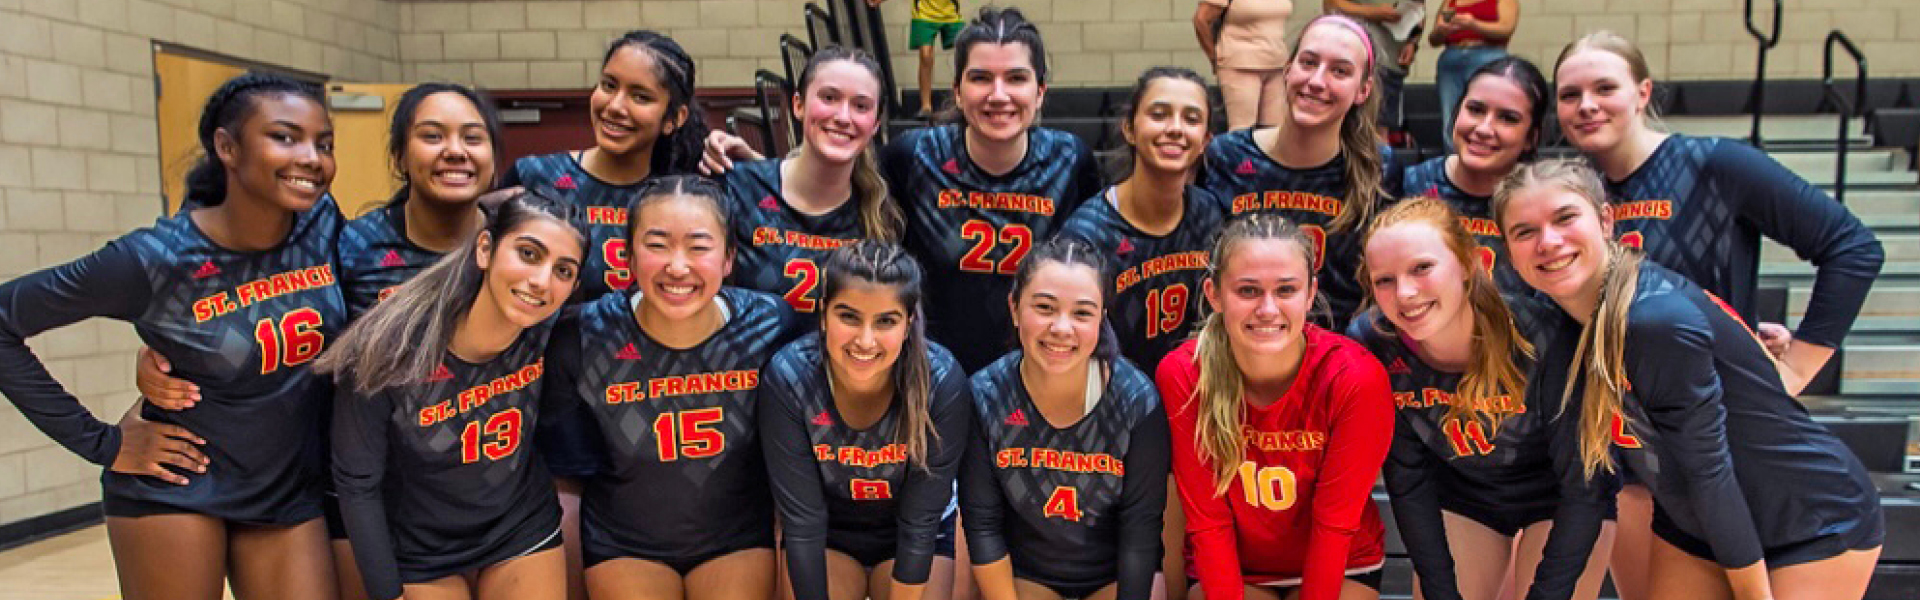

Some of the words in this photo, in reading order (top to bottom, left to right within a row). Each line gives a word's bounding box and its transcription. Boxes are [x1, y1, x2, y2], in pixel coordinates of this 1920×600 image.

[939, 189, 967, 208] ST.
[969, 191, 1055, 216] FRANCIS
[1232, 192, 1260, 215] ST.
[1263, 190, 1342, 216] FRANCI
[752, 226, 784, 247] ST.
[959, 219, 1033, 274] 22
[192, 290, 238, 323] ST.
[236, 262, 336, 308] FRANCIS
[783, 257, 827, 313] 2
[1116, 266, 1141, 293] ST.
[1145, 283, 1189, 339] 19
[255, 305, 325, 375] 16
[606, 380, 645, 404] ST.
[649, 368, 759, 399] FRANCIS
[419, 398, 456, 427] ST.
[461, 407, 522, 463] 13
[653, 406, 725, 462] 15
[1240, 425, 1325, 452] FRANCIS
[813, 443, 836, 462] T.
[838, 443, 908, 468] FRANC
[996, 447, 1028, 469] ST.
[1031, 447, 1125, 477] FRANCIS
[1043, 485, 1084, 522] 4
[1238, 460, 1298, 512] 10
